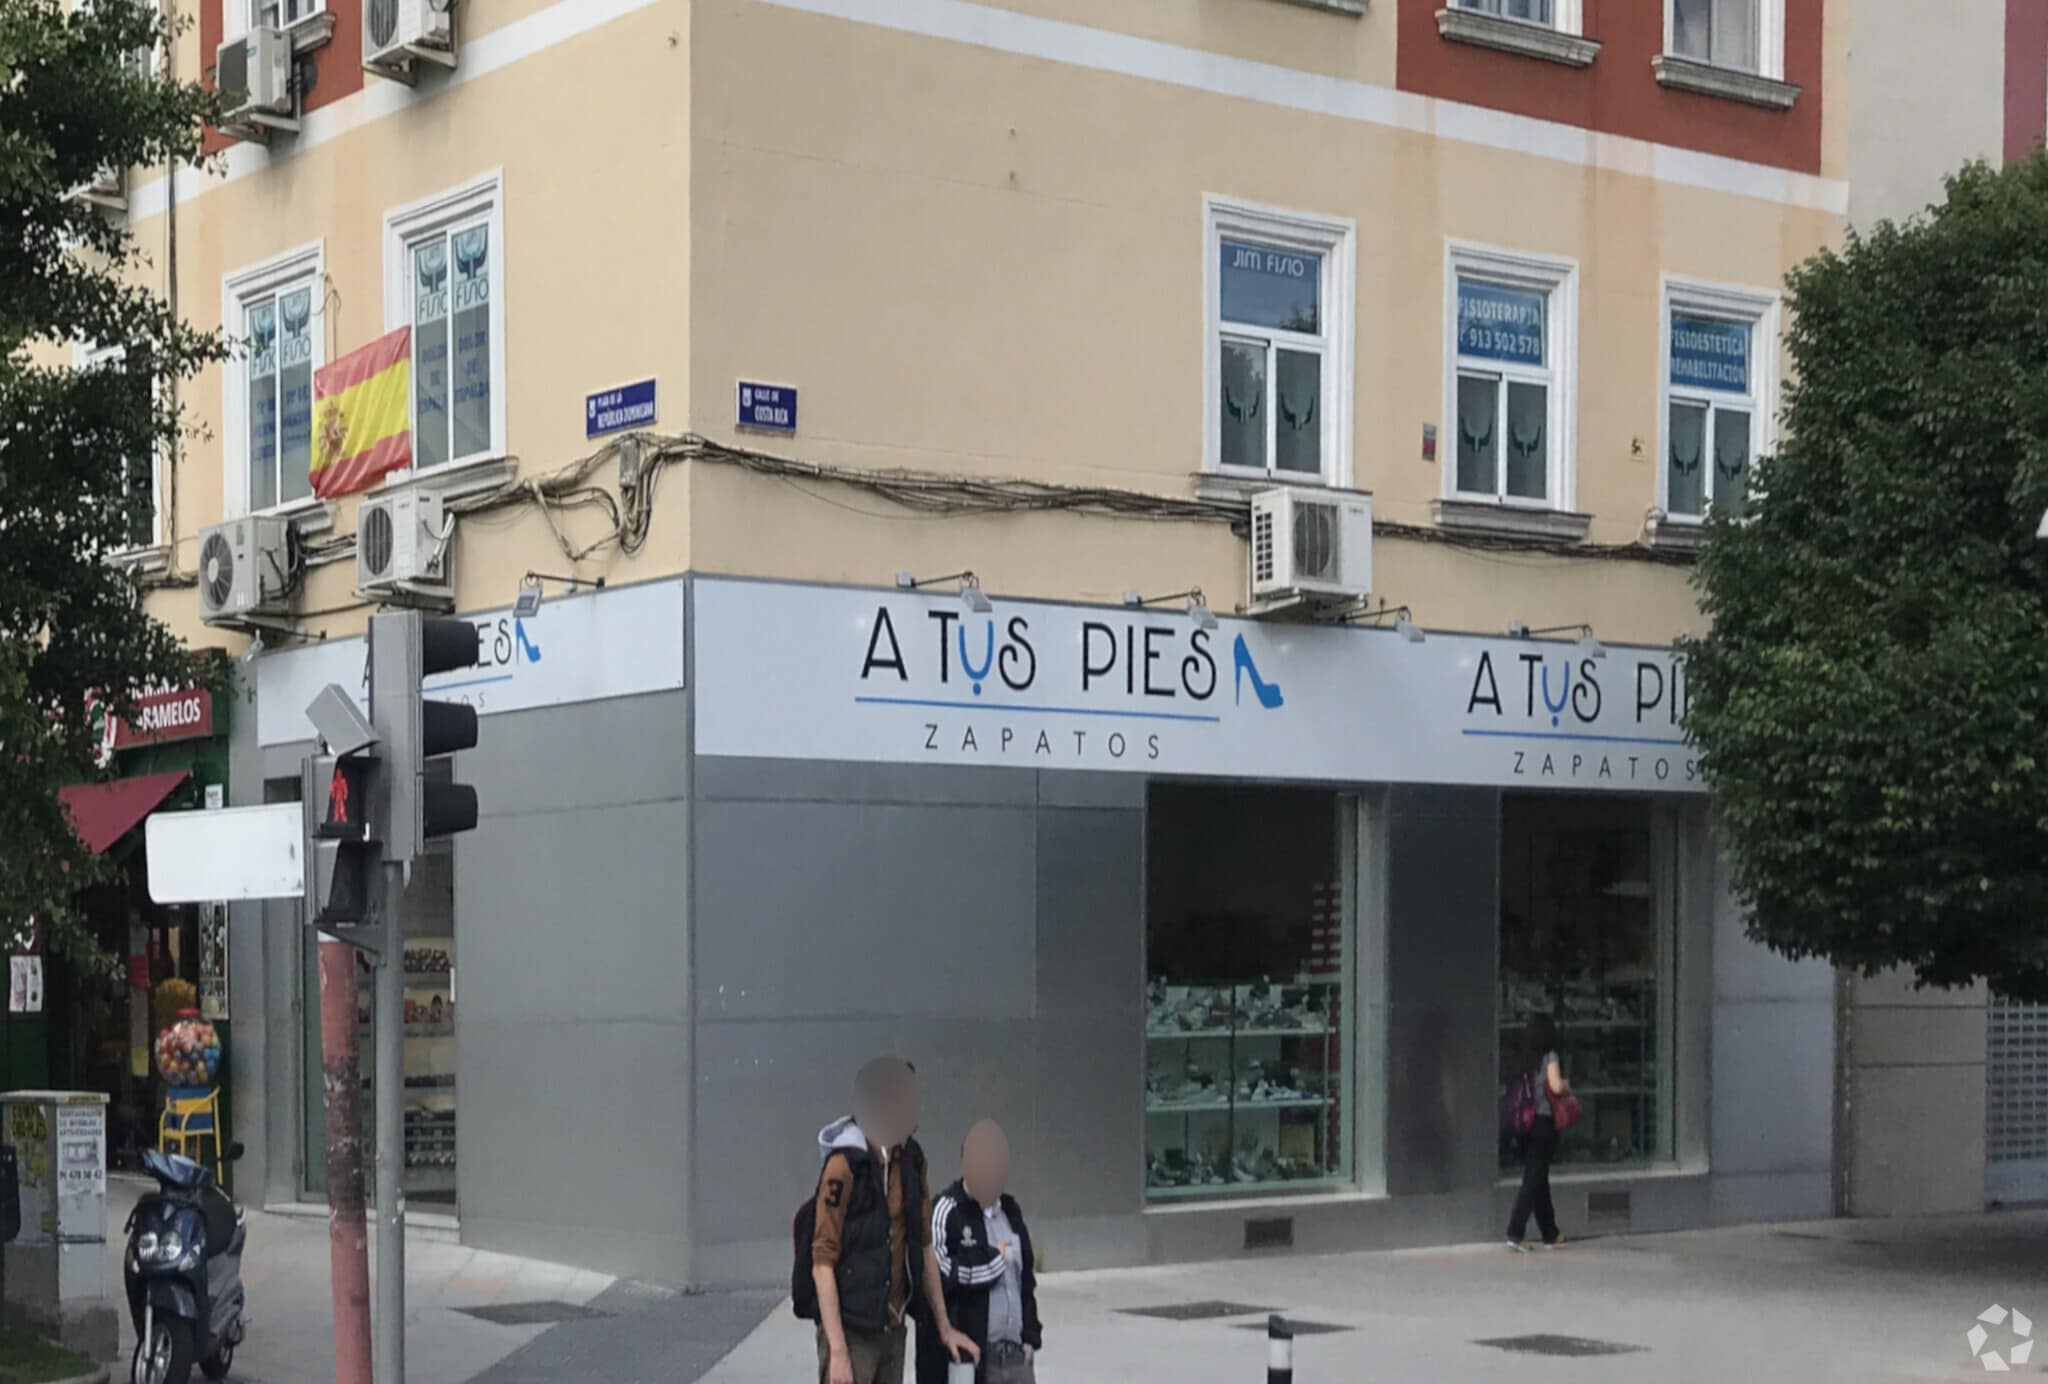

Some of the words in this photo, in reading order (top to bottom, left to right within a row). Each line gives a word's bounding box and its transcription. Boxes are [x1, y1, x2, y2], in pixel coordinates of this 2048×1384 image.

[1233, 248, 1261, 271] JIM
[1266, 254, 1305, 278] FISIO
[1470, 328, 1492, 350] 913
[1495, 331, 1517, 353] 502
[1519, 335, 1541, 355] 578
[860, 606, 908, 682] A
[928, 609, 1036, 696] TUS
[1082, 621, 1217, 701] PIES
[1467, 650, 1503, 716] A
[1519, 653, 1602, 728] TUS
[1635, 661, 1688, 725] PI
[136, 697, 201, 731] RAMELOS
[924, 723, 1160, 760] ZAPATOS
[1513, 751, 1697, 782] ZAPATOS
[825, 1178, 843, 1208] 3
